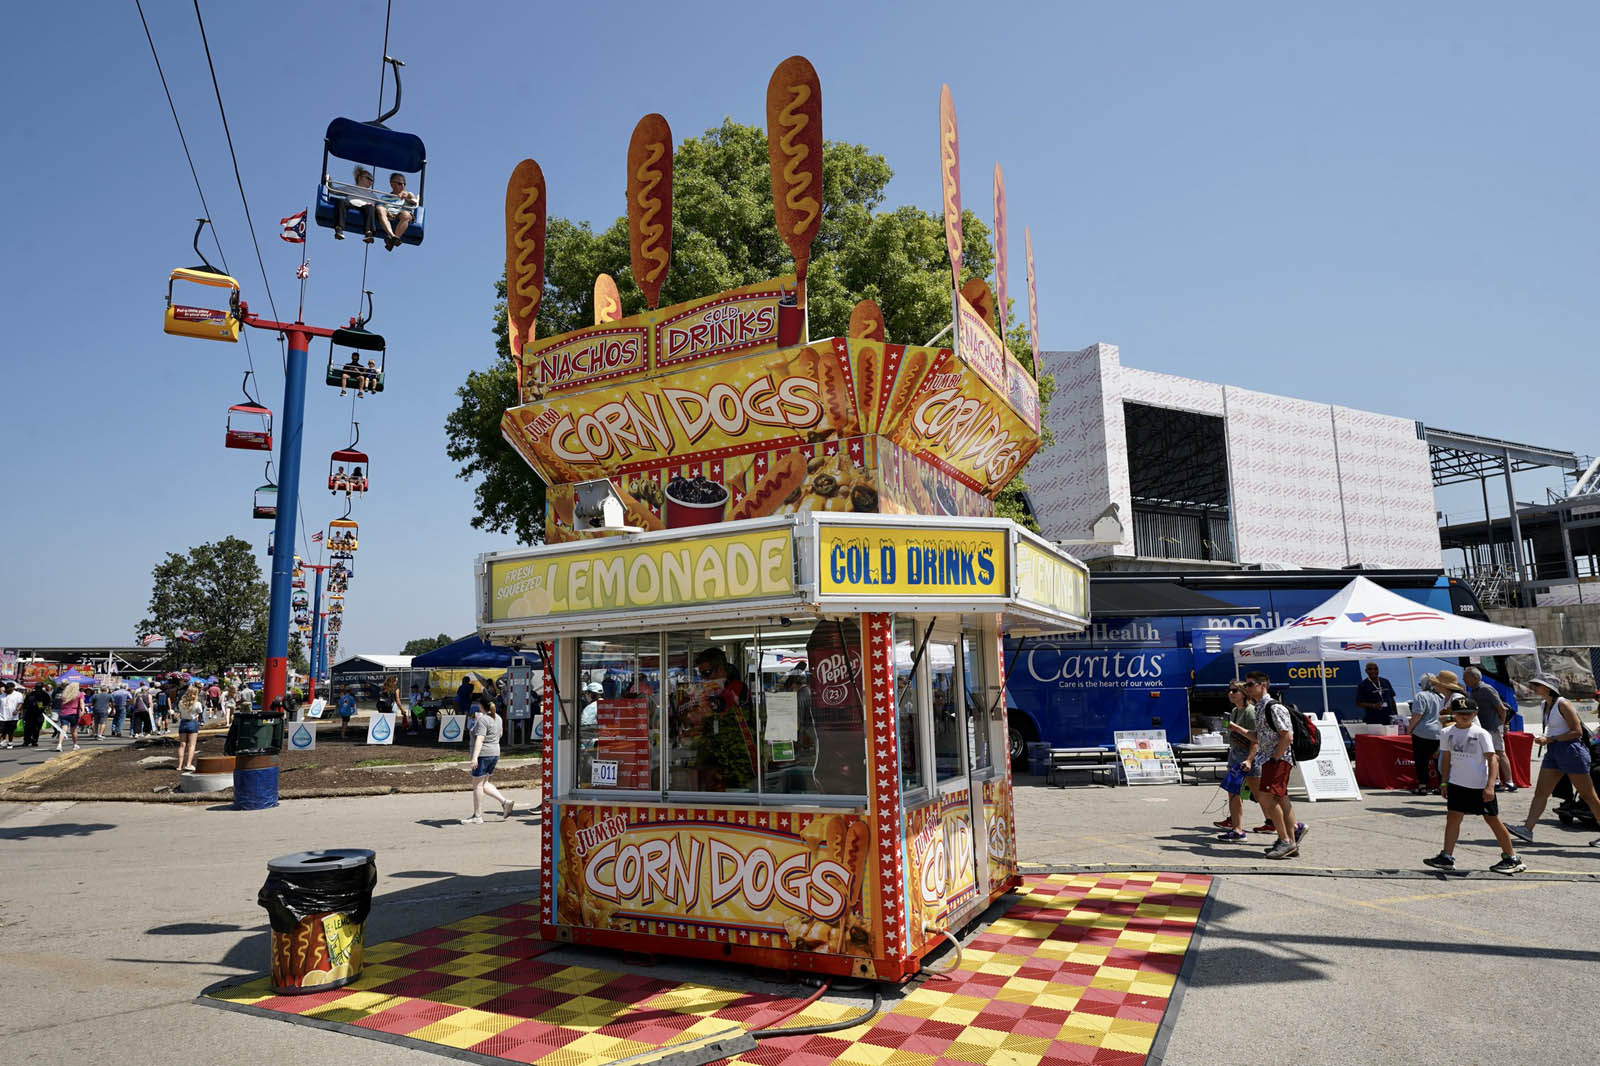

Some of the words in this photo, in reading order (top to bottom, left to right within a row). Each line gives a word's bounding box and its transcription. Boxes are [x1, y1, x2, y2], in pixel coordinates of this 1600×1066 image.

[703, 305, 739, 324] COLD
[668, 306, 775, 357] DRINKS
[540, 338, 638, 384] NACHOS
[964, 319, 1001, 379] NACHOS
[923, 373, 962, 394] JUMBO
[523, 408, 561, 443] JUMBO
[550, 394, 673, 464] CORN
[662, 376, 823, 444] DOGS
[913, 388, 993, 459] CORN
[960, 412, 1021, 483] DOGS
[504, 564, 535, 584] FRESH
[547, 537, 791, 611] LEMONADE
[830, 537, 896, 585] COLD
[906, 538, 995, 587] DRINKS
[497, 576, 542, 600] SQUEEZED
[1027, 622, 1160, 641] eriHealth
[1378, 639, 1460, 651] AmeriHealth
[1463, 638, 1510, 650] Caritas
[820, 658, 859, 685] Peppr
[1085, 680, 1097, 688] the
[1099, 680, 1119, 688] heart
[1288, 664, 1340, 679] center
[829, 689, 840, 700] 23
[600, 764, 617, 780] 011
[577, 815, 628, 856] JUMBO
[914, 813, 938, 867] JUMBO
[584, 832, 703, 911] CORN
[709, 838, 854, 921] DOGS
